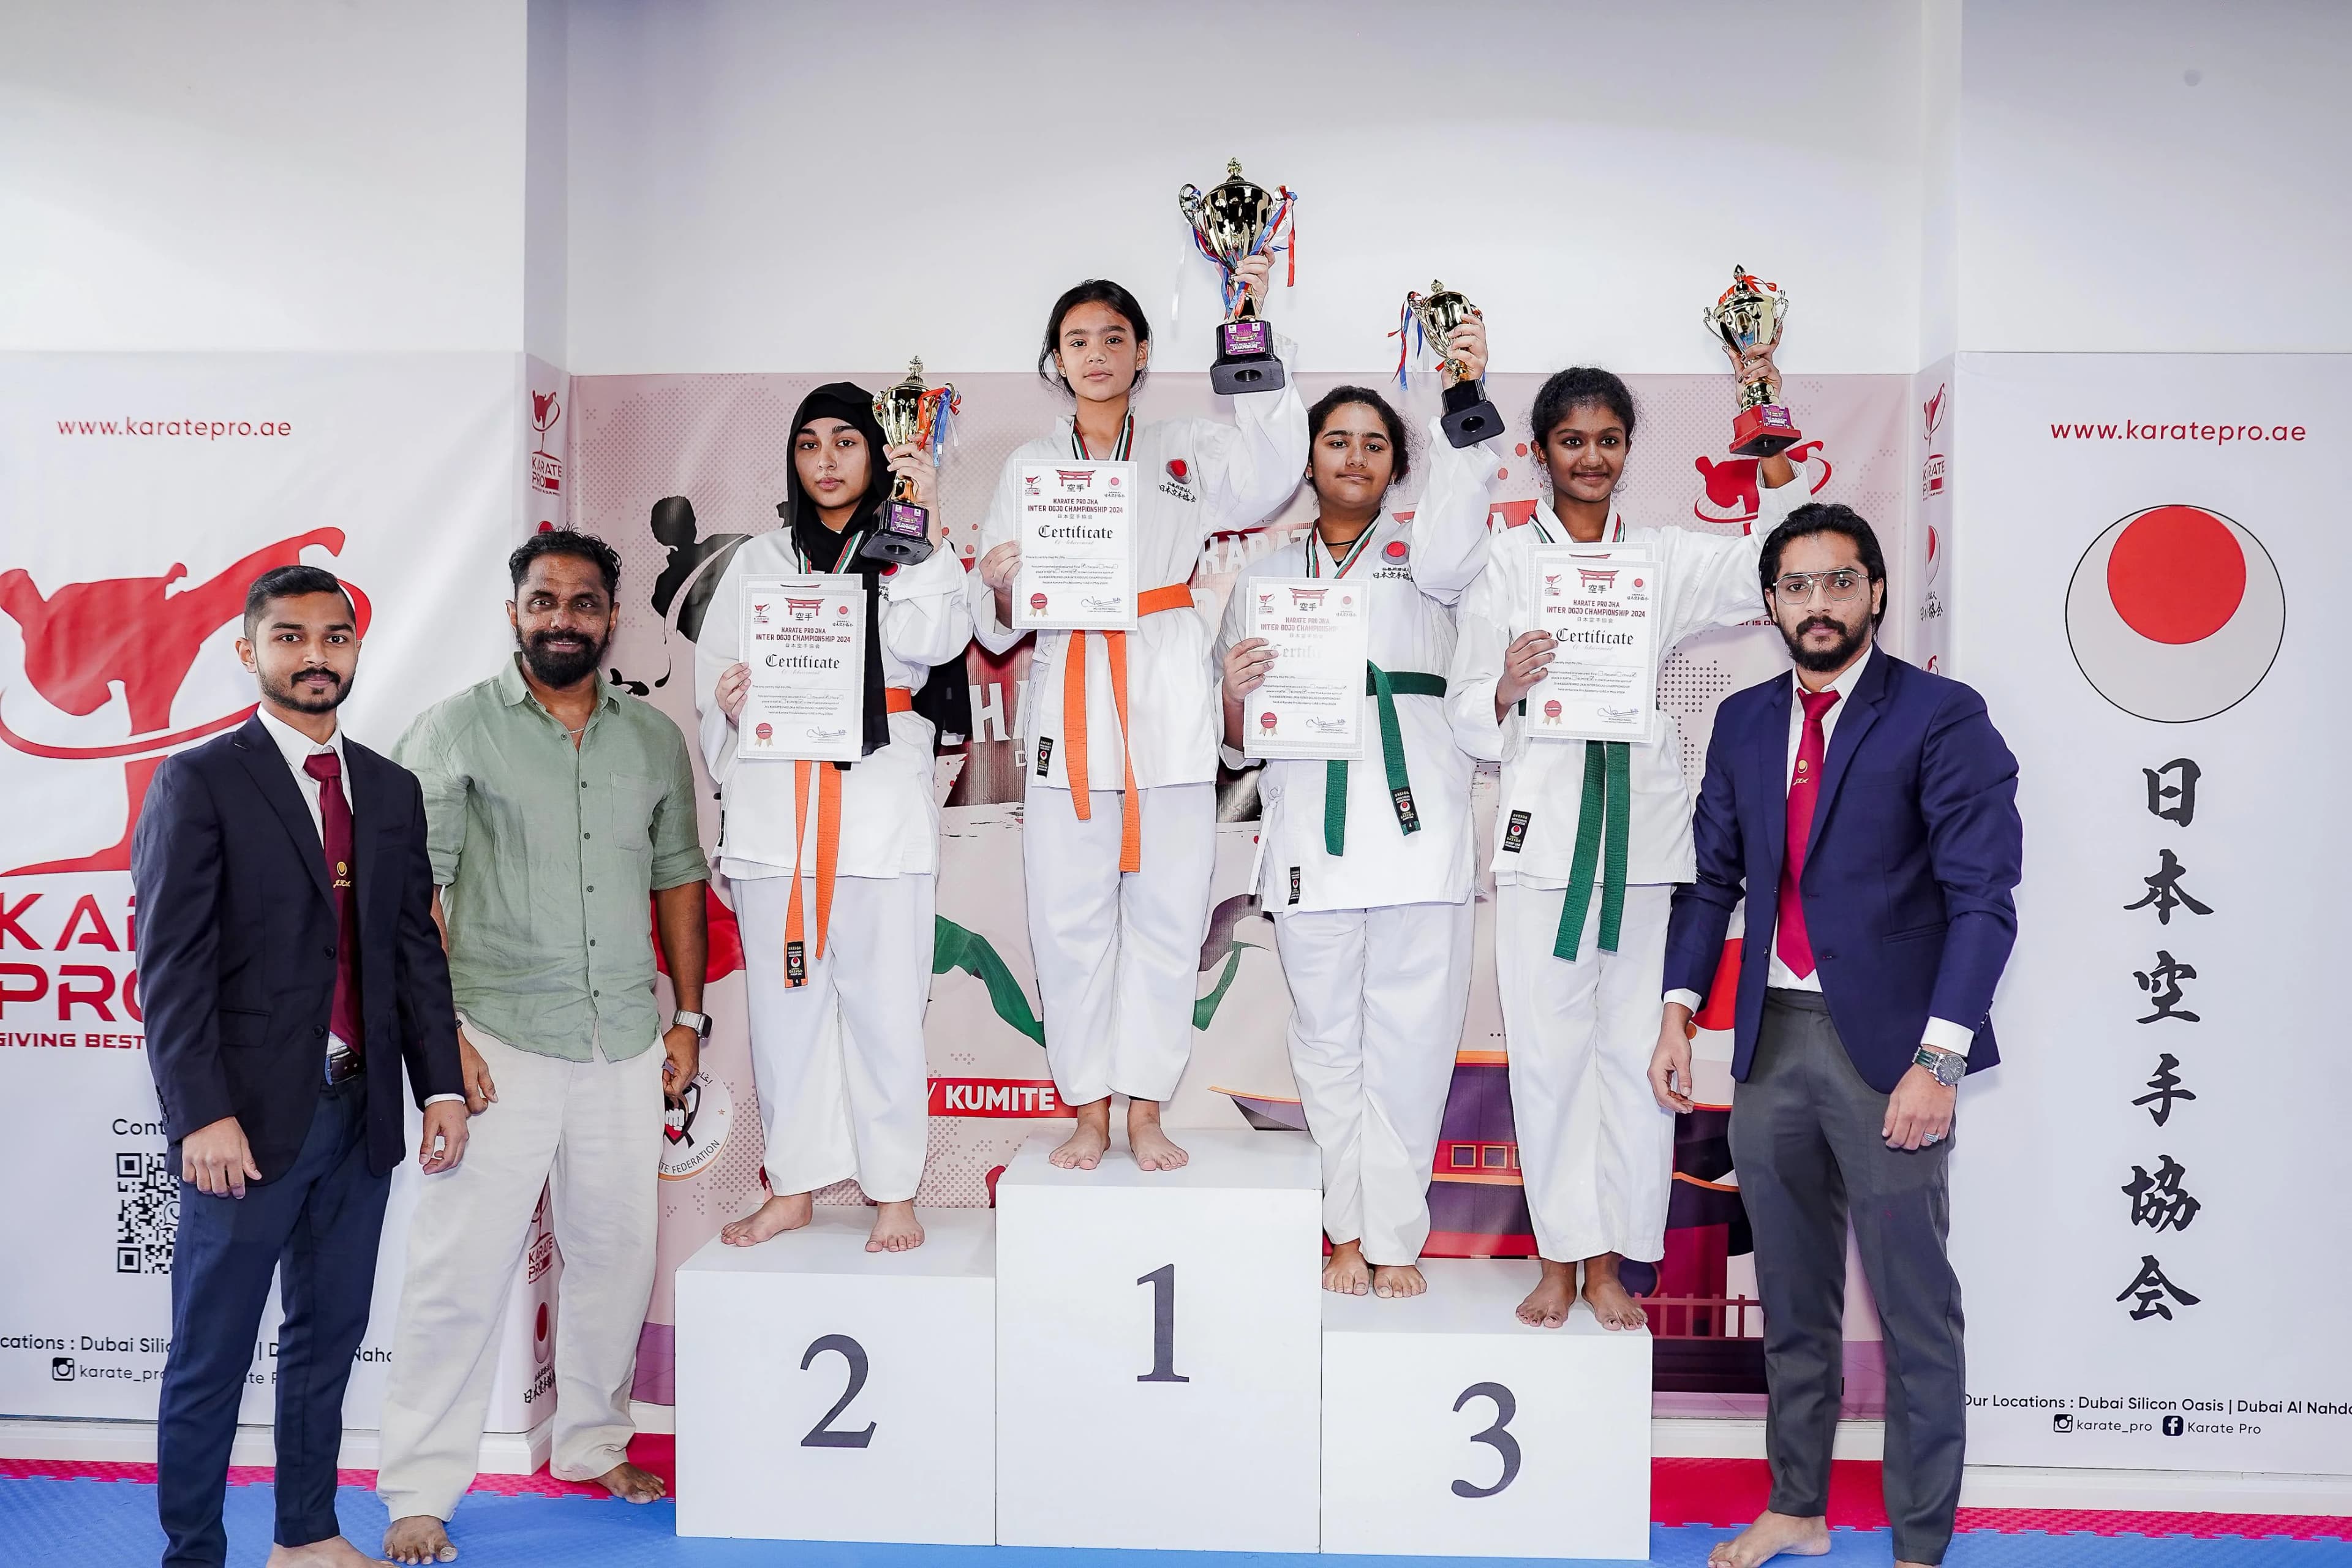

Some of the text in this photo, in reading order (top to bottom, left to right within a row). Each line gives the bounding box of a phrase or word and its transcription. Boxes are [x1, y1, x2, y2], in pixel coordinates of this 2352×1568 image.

[58, 417, 292, 440] www.karatepro.ae
[2051, 420, 2307, 445] www.karatepro.ae
[532, 456, 562, 477] KARATE
[532, 471, 545, 488] PRO
[1038, 525, 1113, 538] Certificate
[1588, 584, 1607, 594] 空手
[1299, 603, 1317, 611] 空手
[1585, 608, 1629, 617] CHAMPIONSHIP
[796, 612, 813, 621] 空手
[1556, 628, 1634, 645] Certificate
[766, 654, 840, 669] Certificate
[0, 892, 136, 952] KA
[946, 1085, 1055, 1111] KUMITE
[672, 1139, 720, 1174] FEDERATION
[1137, 1264, 1189, 1382] 1
[81, 1336, 134, 1352] Dubai
[801, 1334, 876, 1448] 2
[1993, 1394, 2065, 1408] Locations
[2079, 1396, 2124, 1409] Dubai
[2128, 1396, 2177, 1411] Silicon
[2182, 1398, 2224, 1412] Oasis
[2237, 1400, 2282, 1413] Dubai
[2287, 1401, 2302, 1414] Al
[2077, 1420, 2152, 1434] karate_pro
[2188, 1422, 2234, 1434] Karate
[2239, 1423, 2261, 1434] Pro
[1452, 1382, 1521, 1498] 3
